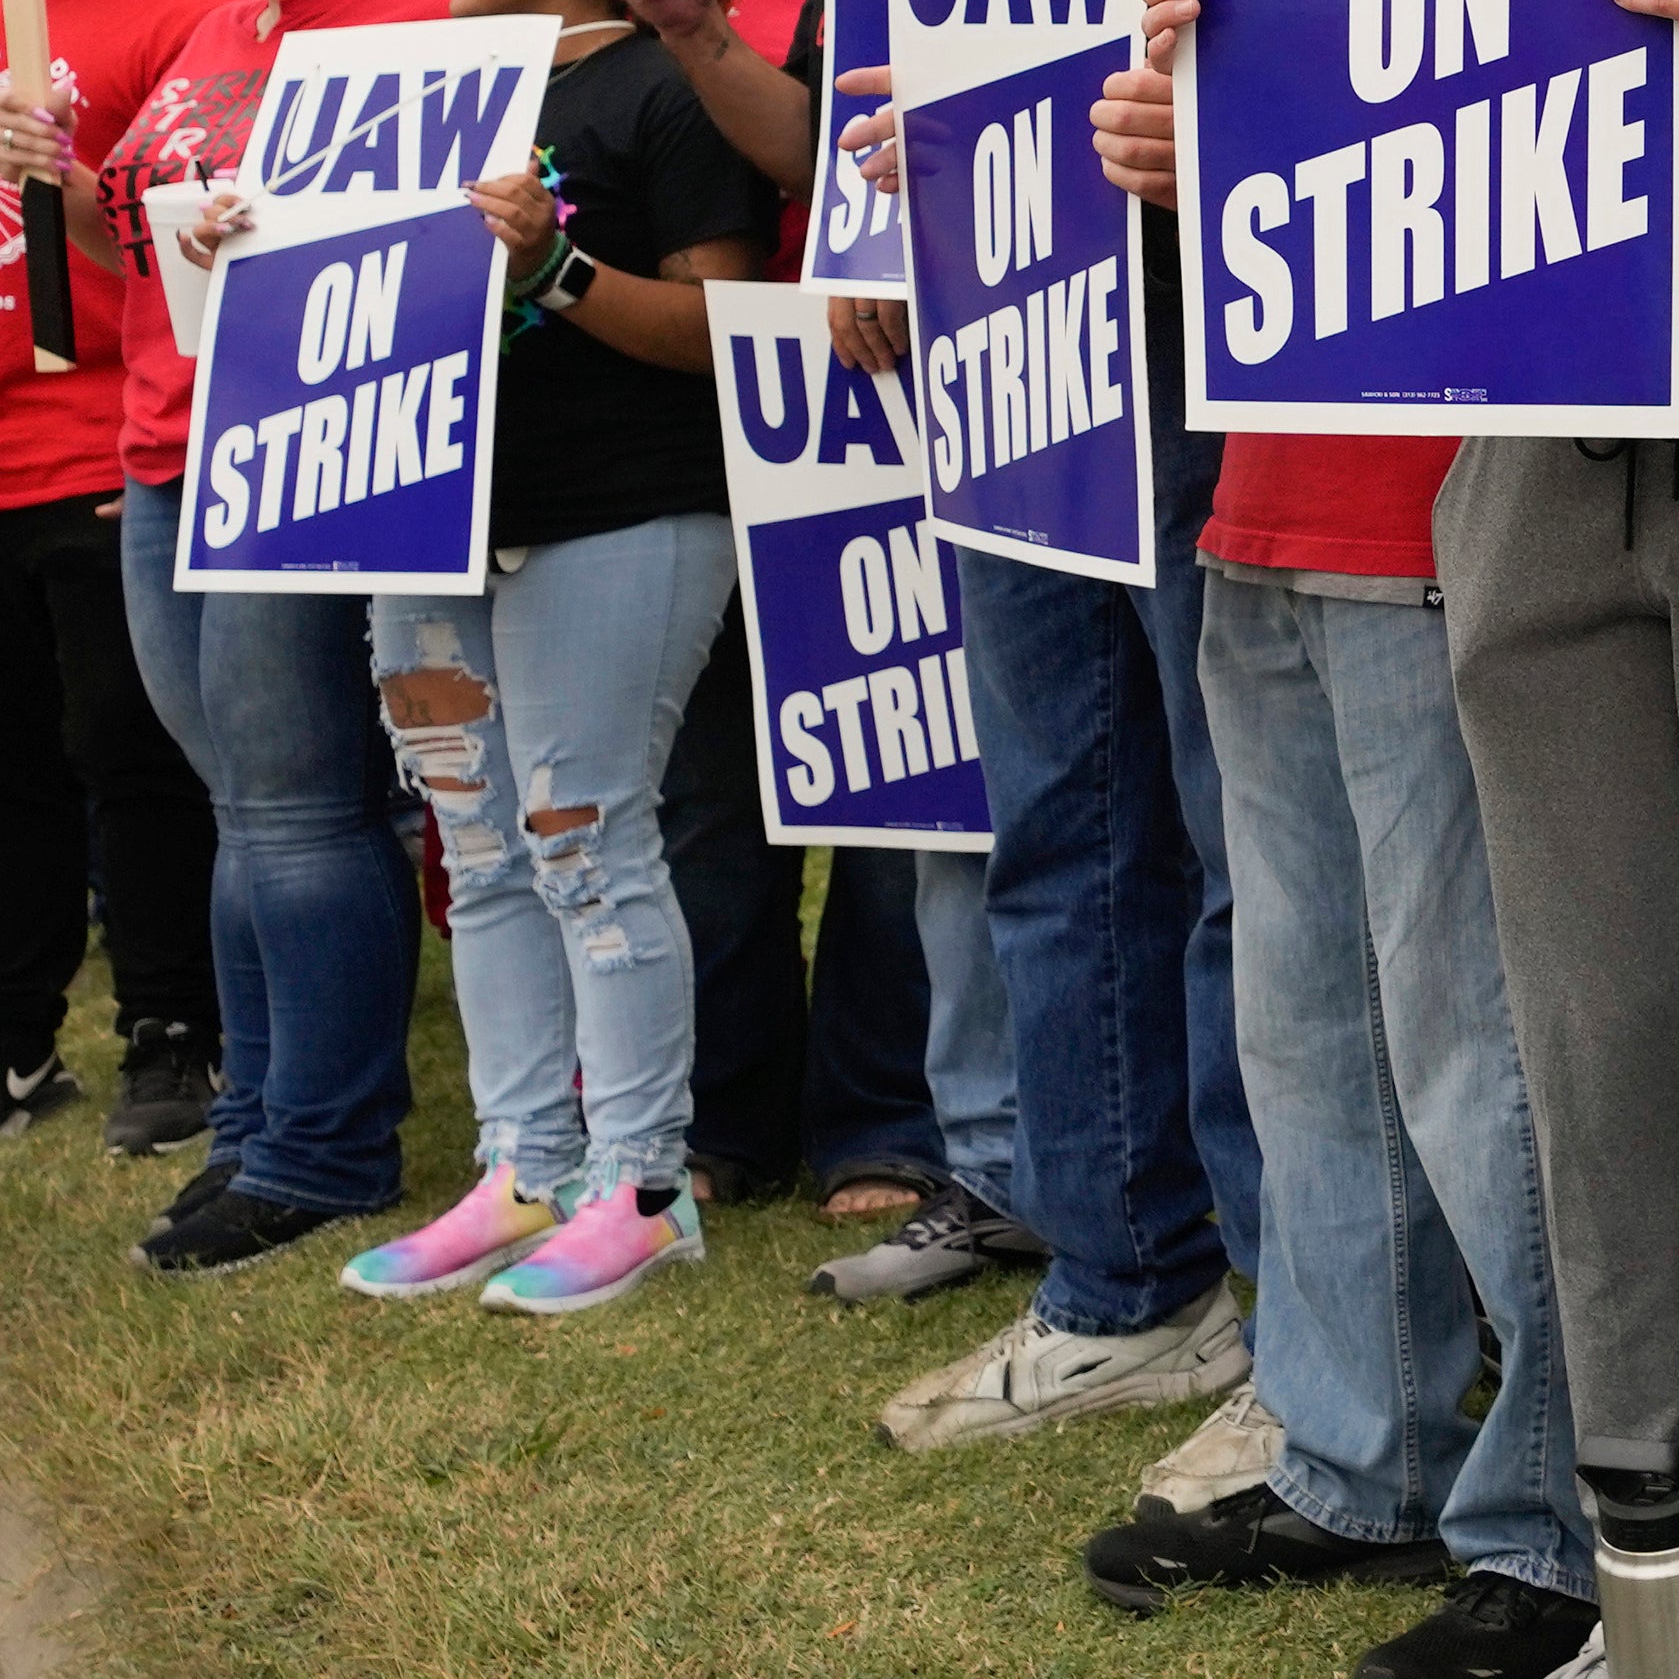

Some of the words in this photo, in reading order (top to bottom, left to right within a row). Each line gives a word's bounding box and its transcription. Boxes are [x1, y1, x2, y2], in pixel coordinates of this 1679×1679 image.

[151, 69, 268, 108] STRI
[262, 66, 525, 198] UAW
[972, 97, 1053, 288] ON
[1220, 46, 1649, 367] STRIKE
[297, 241, 408, 386] ON
[927, 255, 1123, 494] STRIKE
[203, 349, 469, 550] STRIKE
[730, 334, 921, 465] UA
[838, 521, 948, 657] ON
[779, 647, 981, 808] STRI
